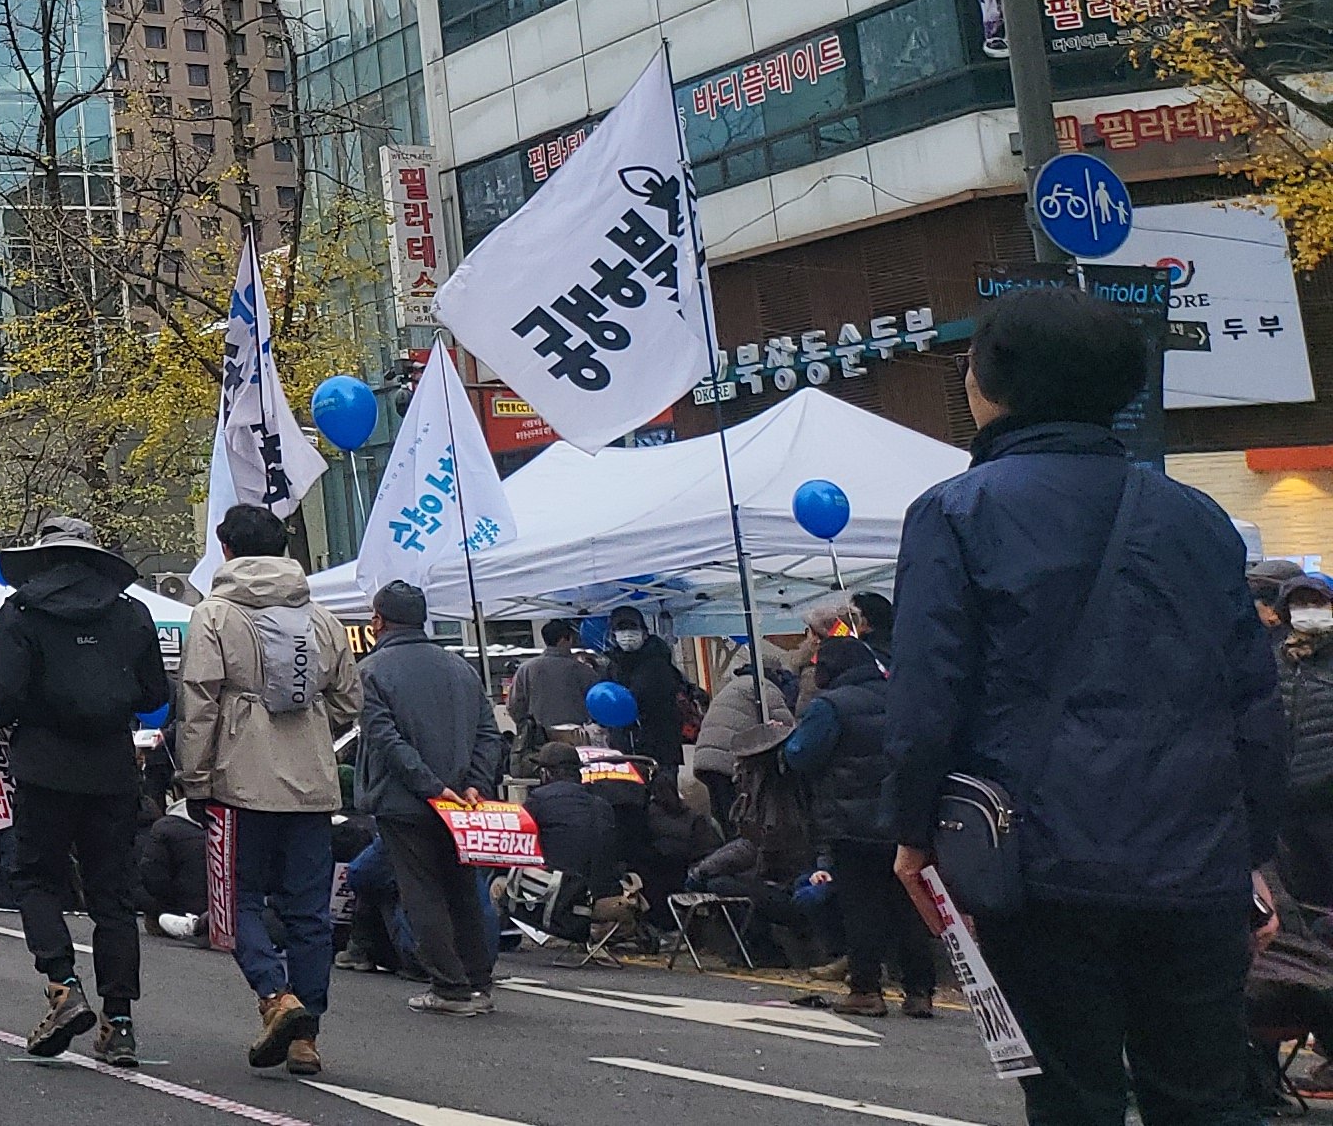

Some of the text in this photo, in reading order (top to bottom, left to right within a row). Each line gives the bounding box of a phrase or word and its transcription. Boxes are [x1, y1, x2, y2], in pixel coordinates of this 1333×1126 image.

[691, 34, 848, 121] 바디플레이트
[527, 128, 586, 183] 필라테
[1099, 106, 1226, 149] 필라테
[397, 166, 439, 298] 필라테스
[735, 307, 939, 395] 북창동순두부
[291, 635, 308, 704] INOXTO
[465, 831, 537, 855] 타도하자!
